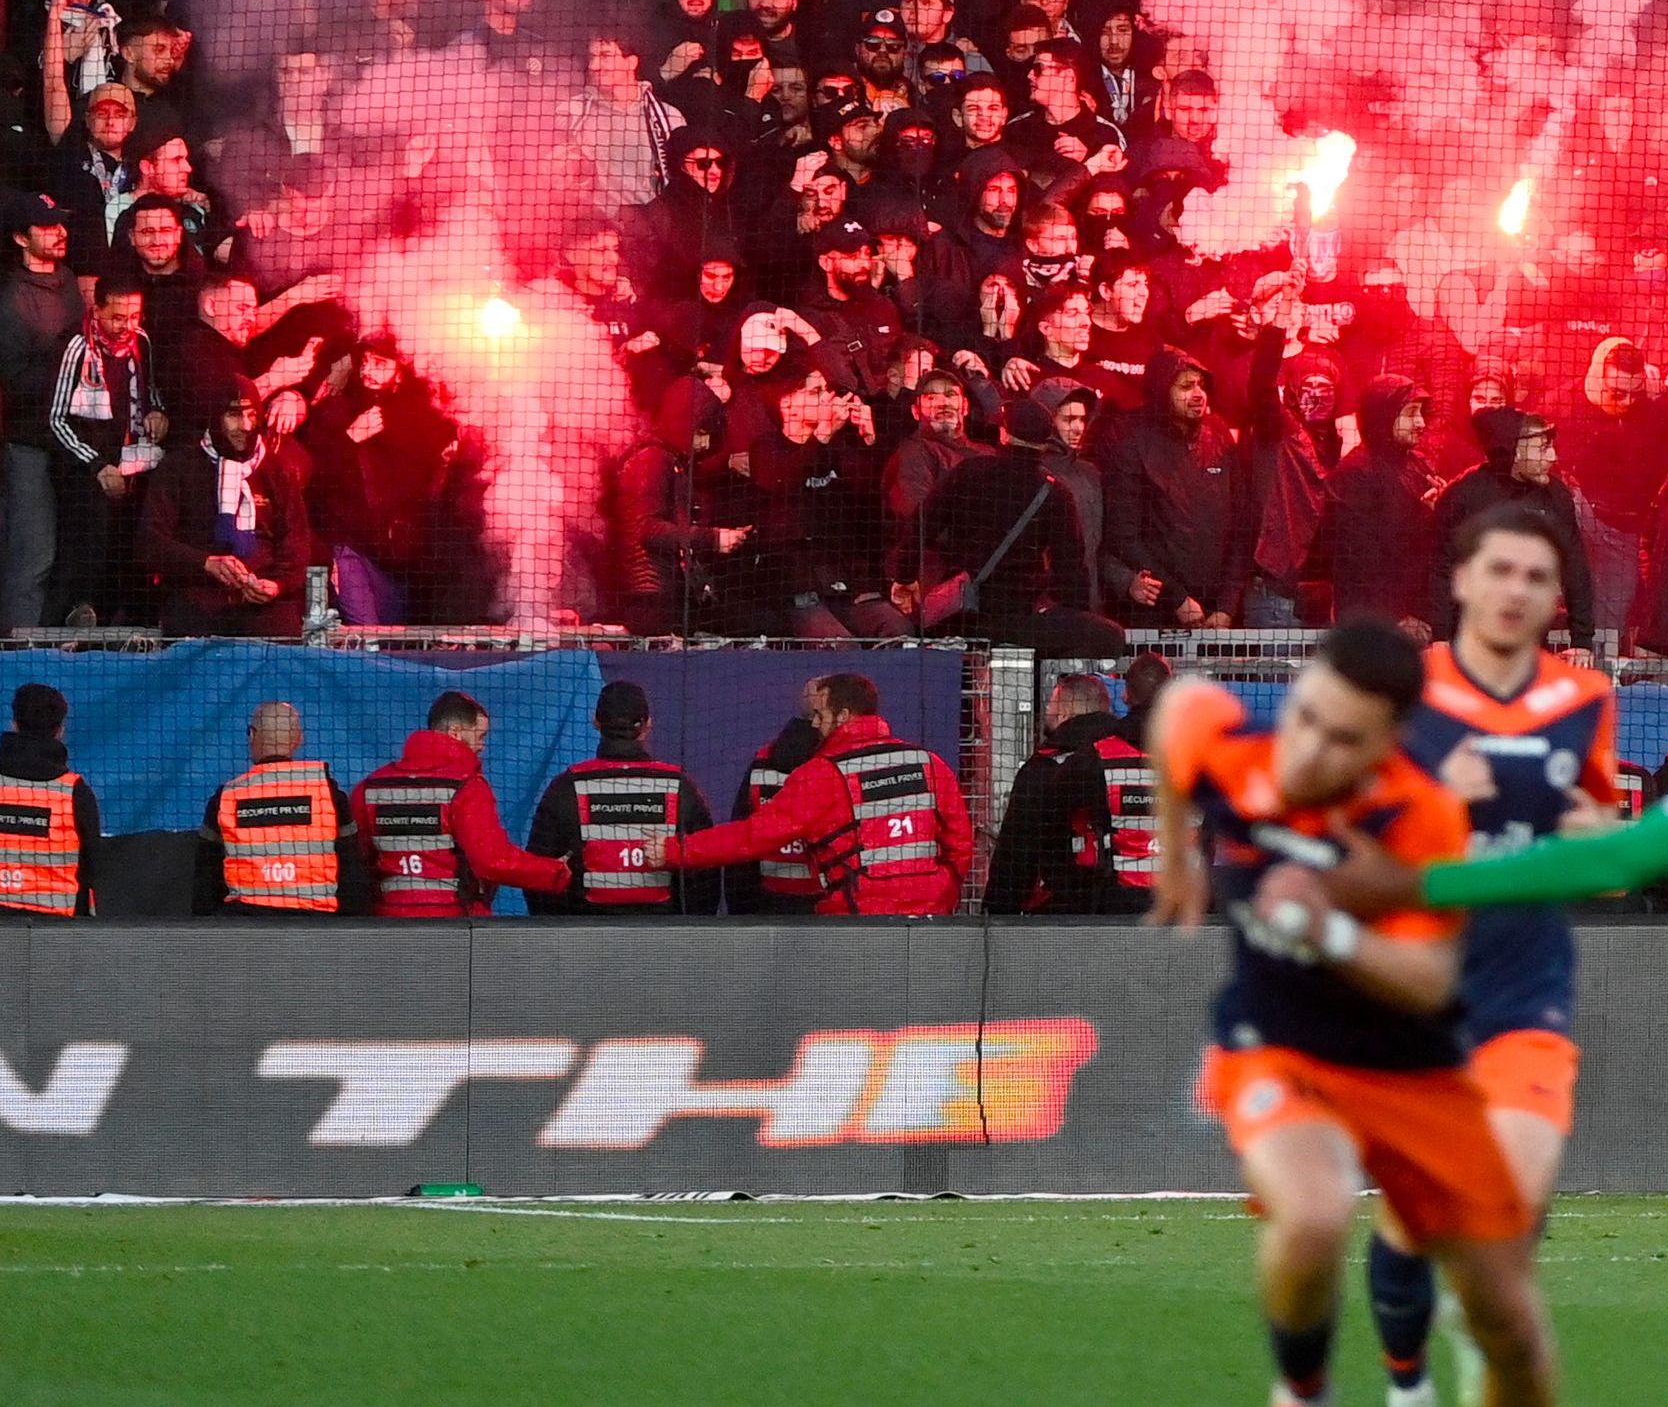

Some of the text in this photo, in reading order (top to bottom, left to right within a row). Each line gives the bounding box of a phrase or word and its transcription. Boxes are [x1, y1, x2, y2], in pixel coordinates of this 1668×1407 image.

[887, 815, 914, 838] 21
[399, 854, 423, 875] 16
[619, 847, 644, 868] 10
[261, 861, 297, 883] 100
